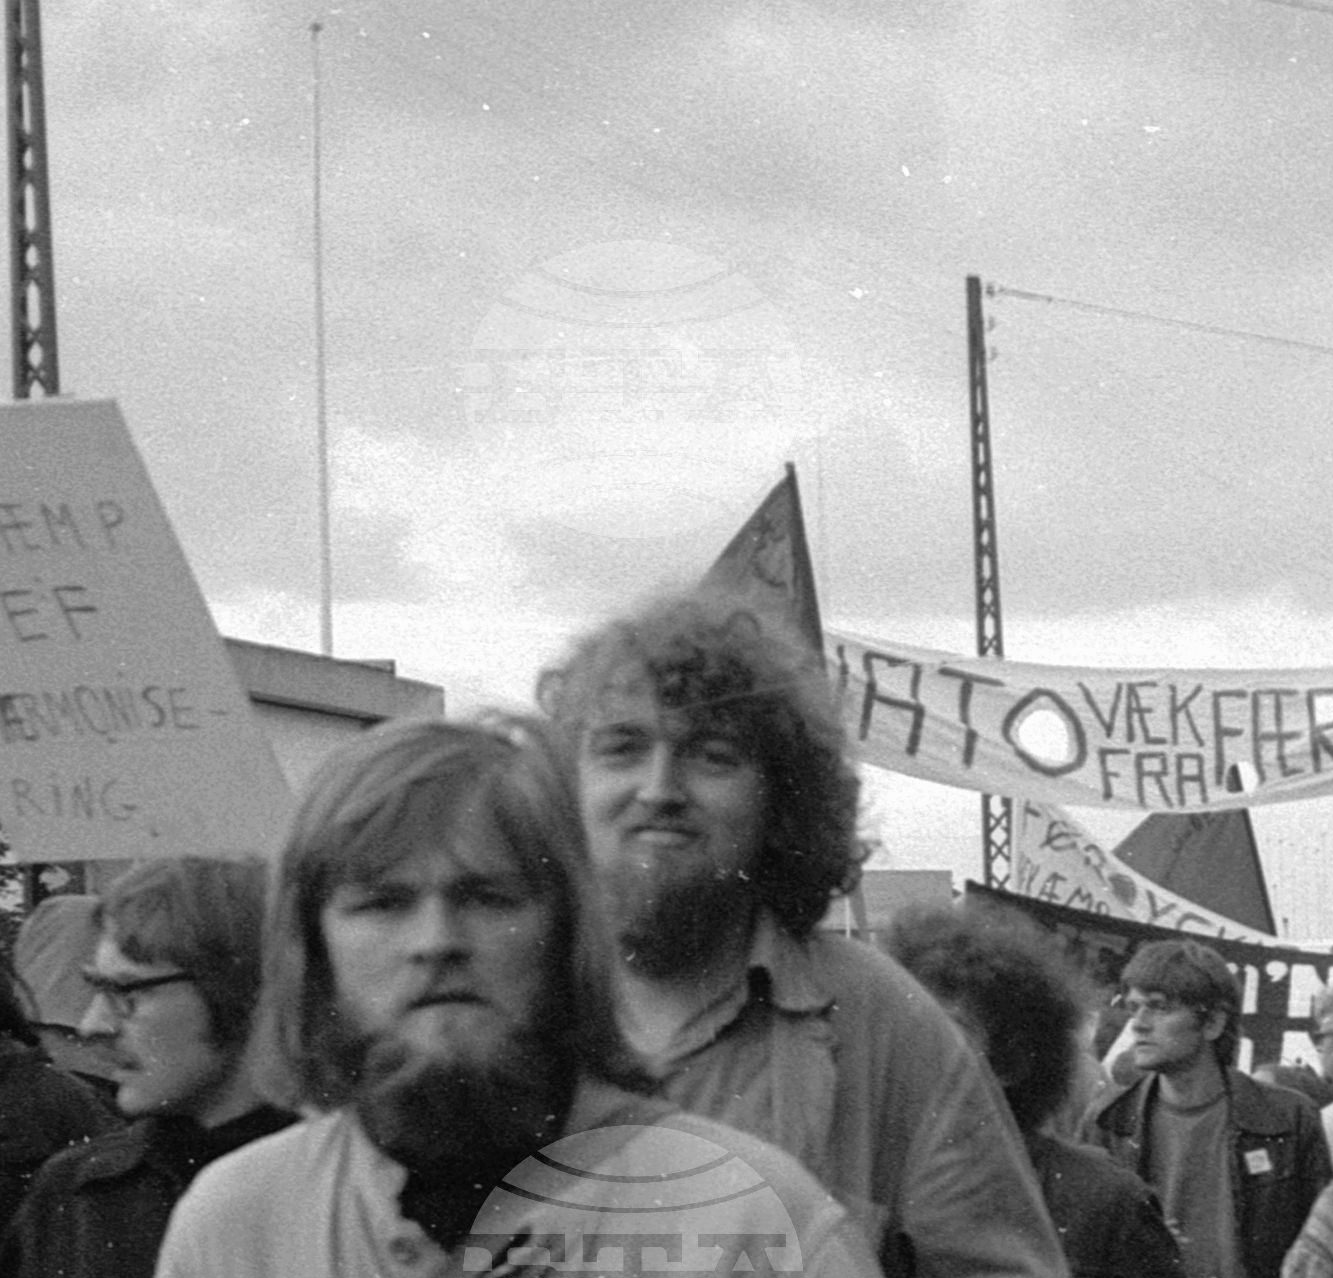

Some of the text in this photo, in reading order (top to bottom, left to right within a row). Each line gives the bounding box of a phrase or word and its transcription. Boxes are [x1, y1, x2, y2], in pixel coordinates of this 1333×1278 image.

[836, 643, 1088, 778] ATO
[1077, 680, 1206, 747] VÆK
[1098, 747, 1210, 807] FRA
